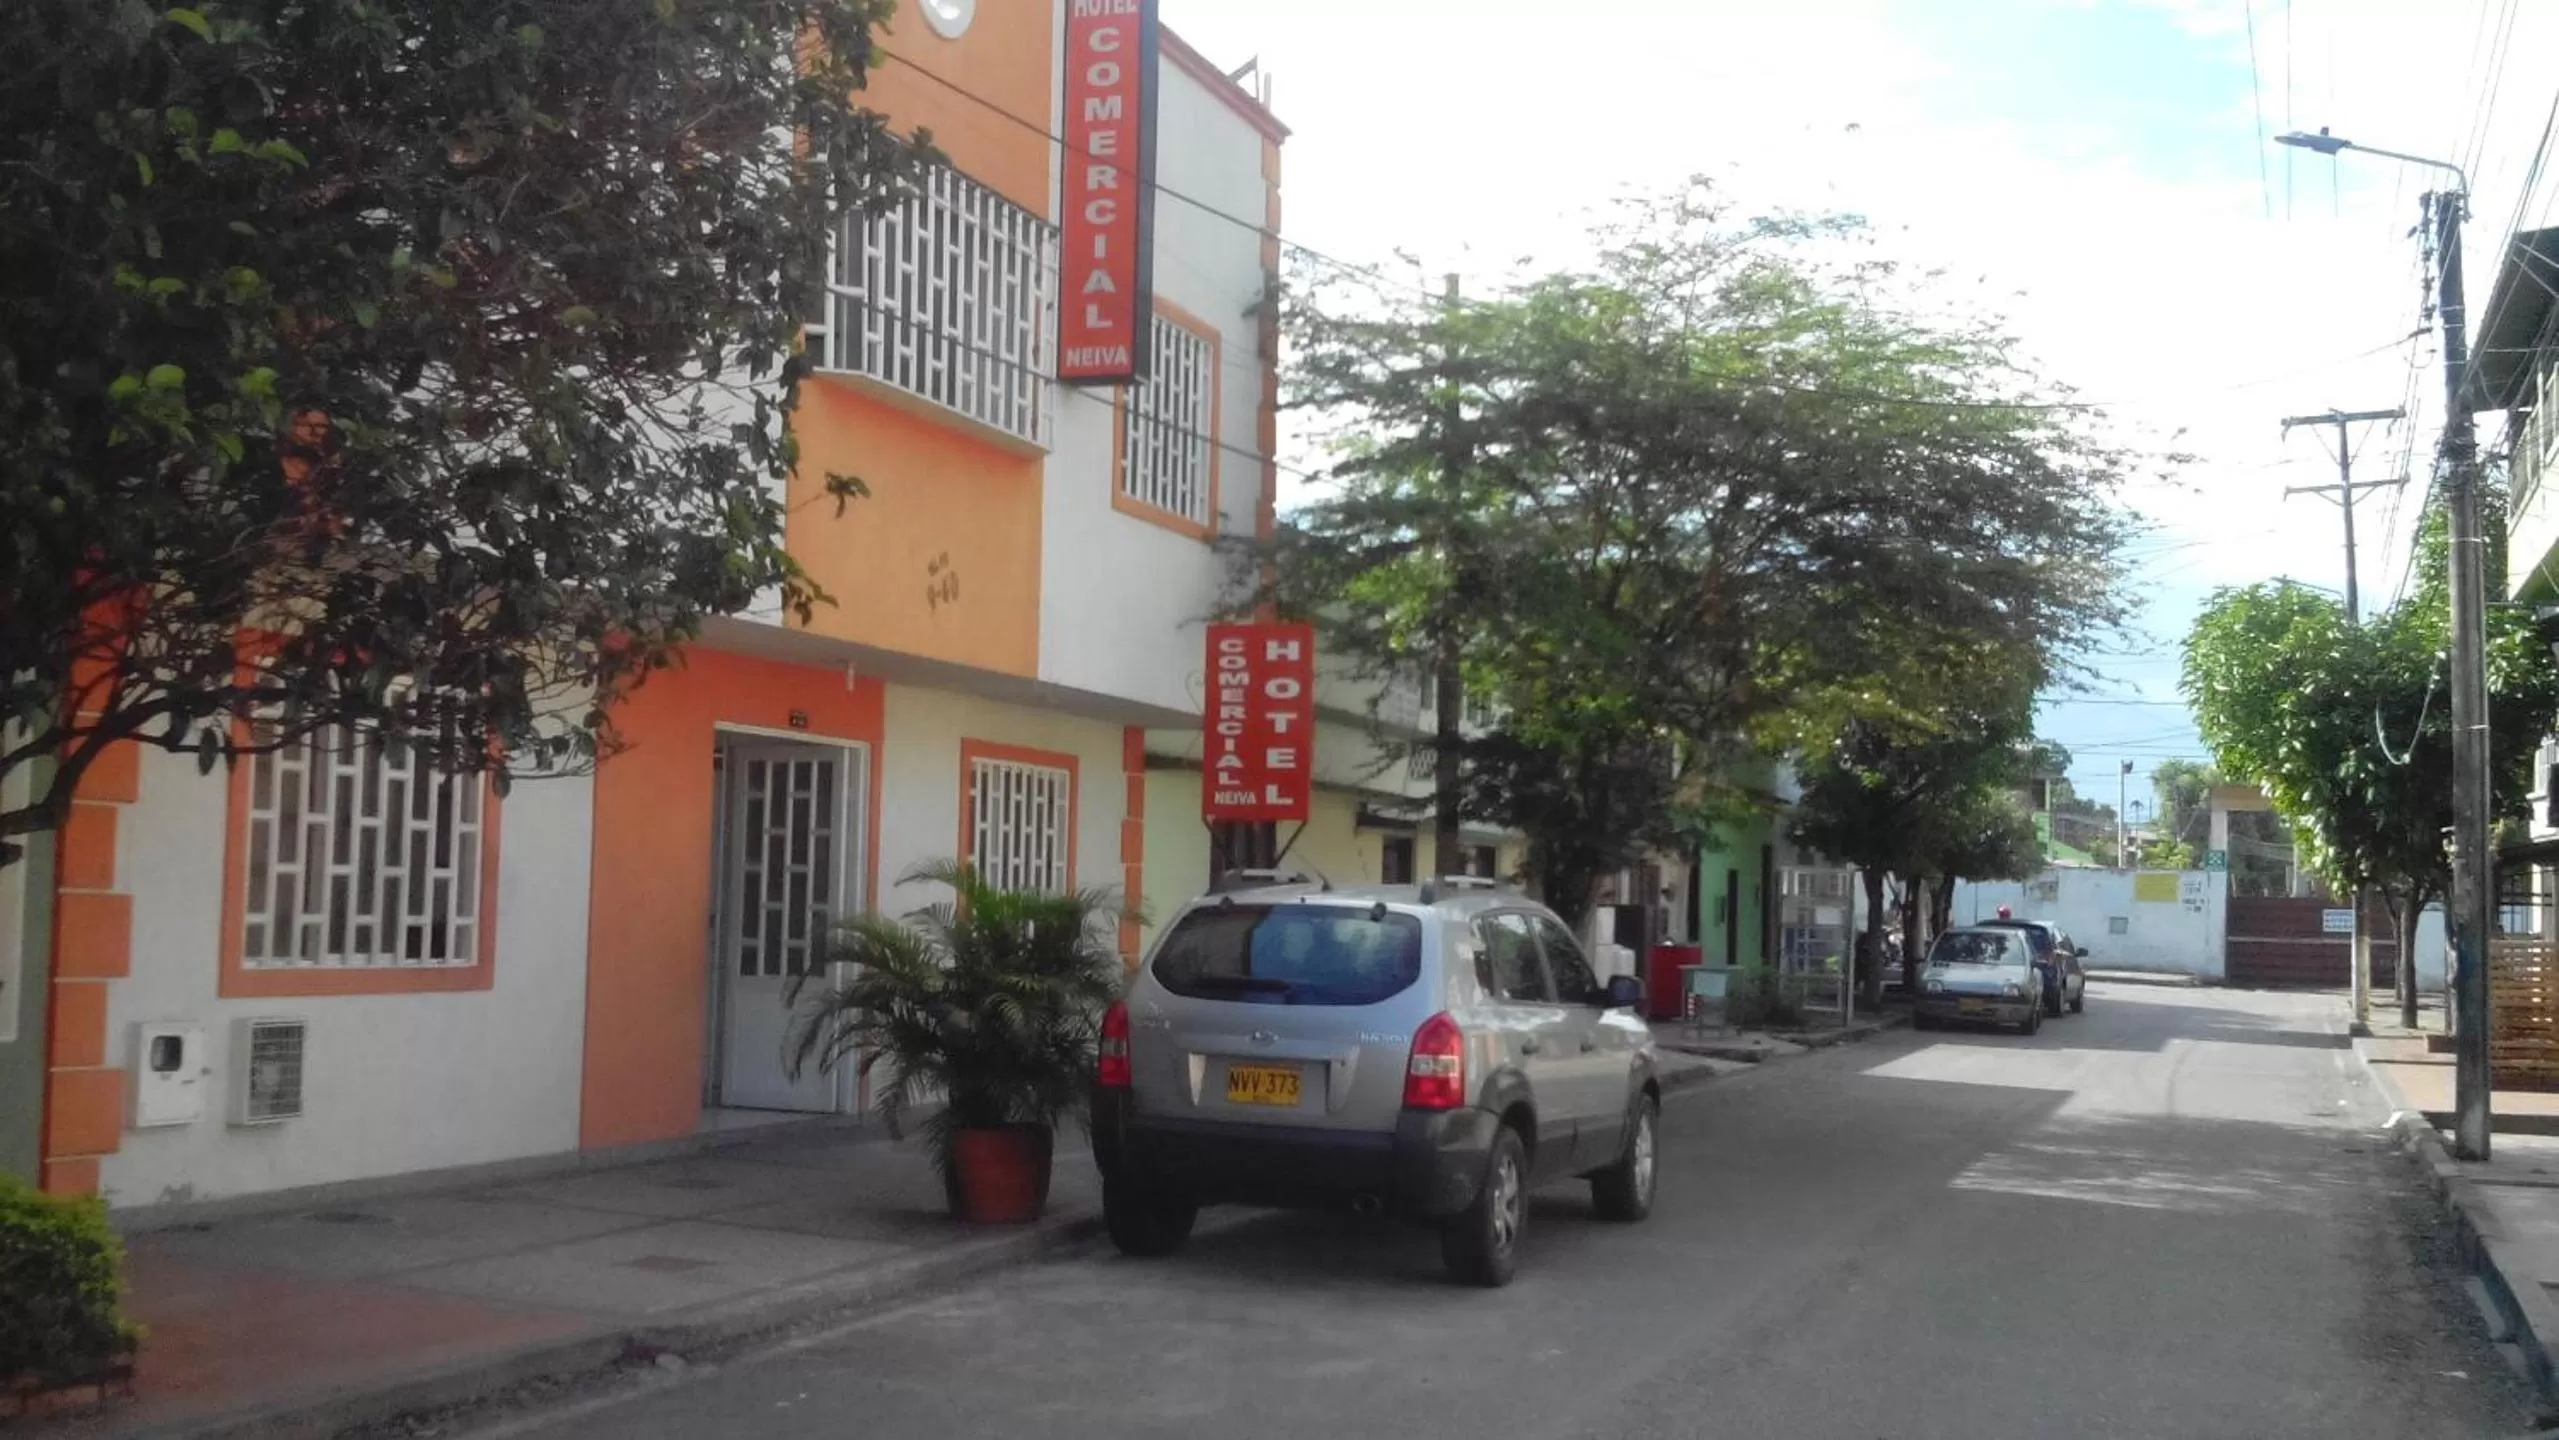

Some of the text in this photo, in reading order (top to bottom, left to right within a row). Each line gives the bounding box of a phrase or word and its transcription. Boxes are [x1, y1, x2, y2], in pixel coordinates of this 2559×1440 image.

[1075, 0, 1138, 17] HOTEL
[1083, 27, 1123, 329] COMERCIAL
[1066, 345, 1128, 368] NEIVA
[1216, 638, 1250, 786] COMERCIAL
[1264, 640, 1301, 806] HOTEL
[1213, 791, 1257, 806] NEIVA
[1229, 1070, 1298, 1096] NVV 373
